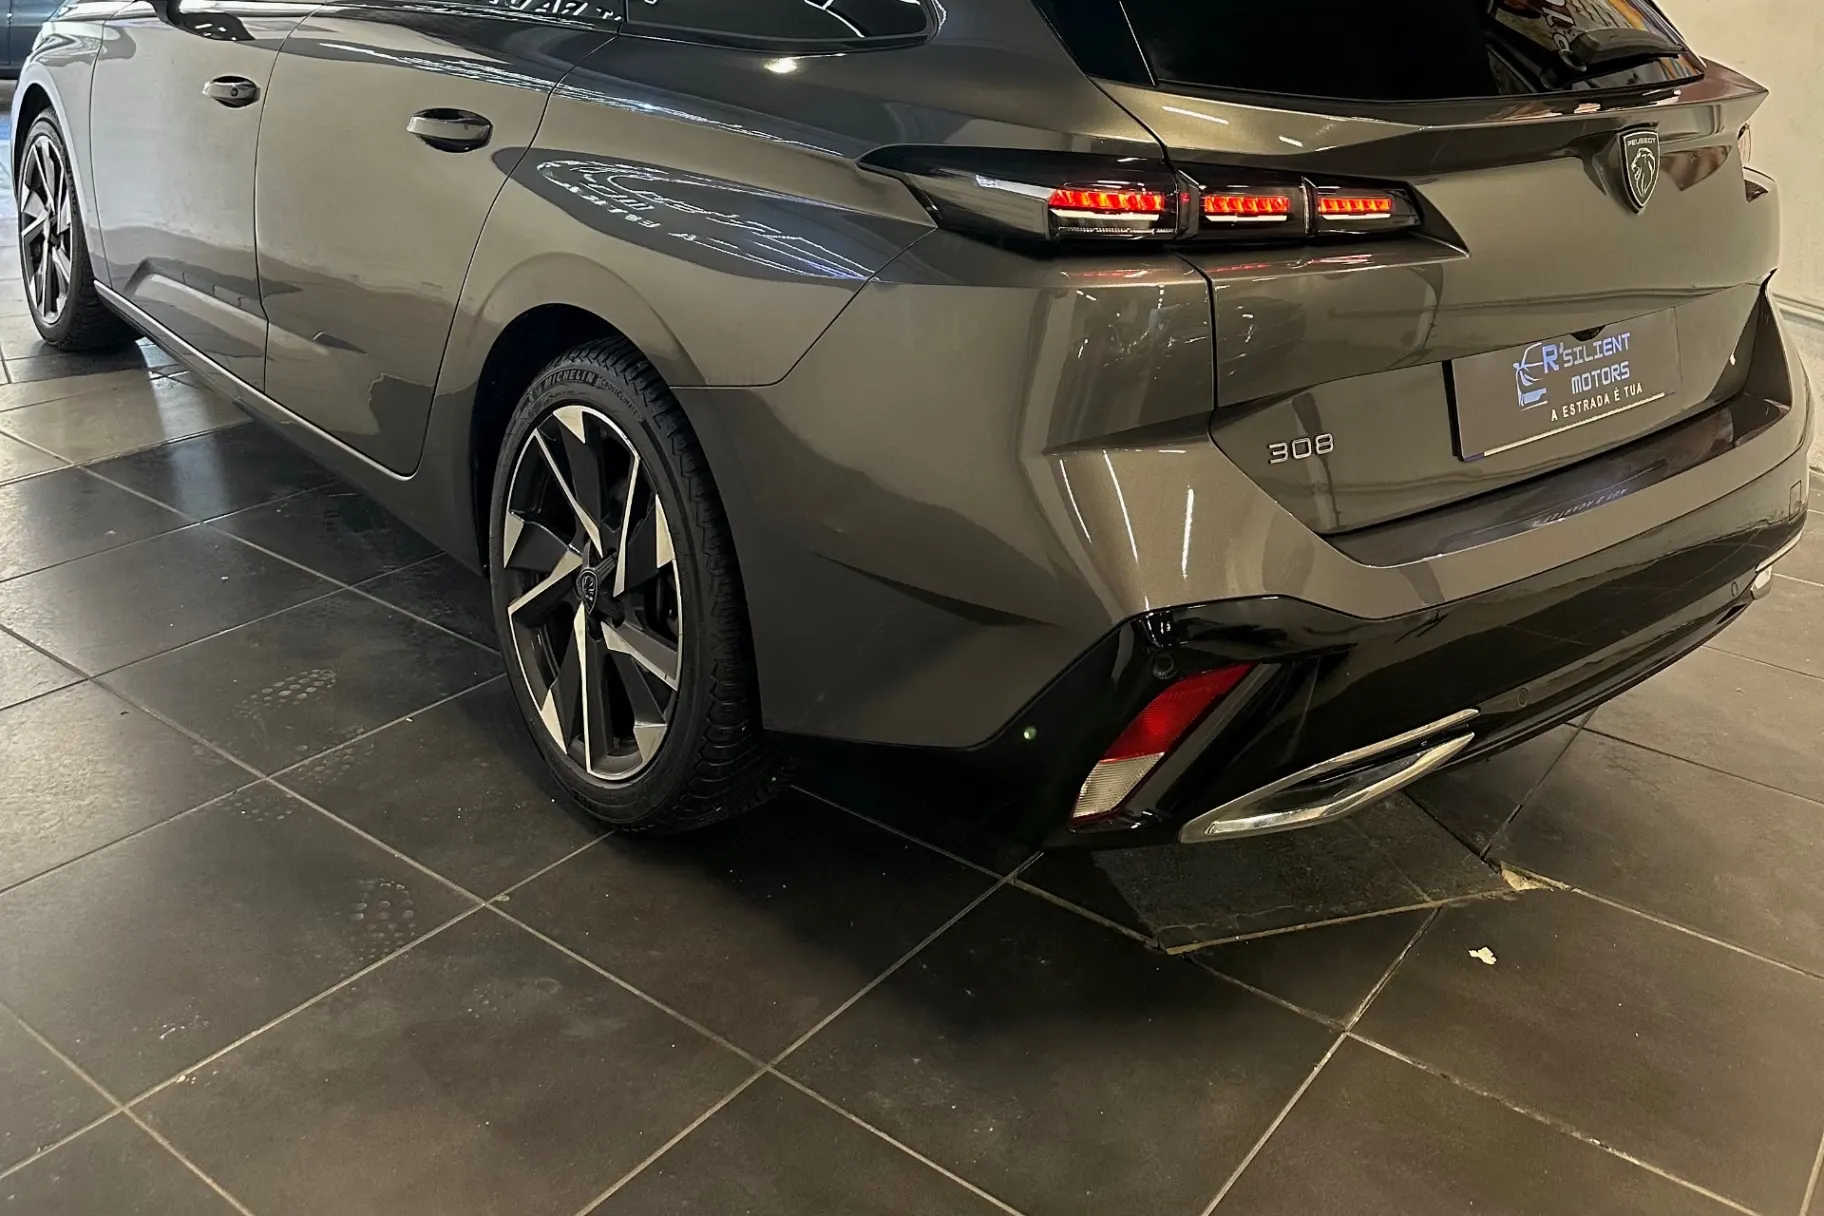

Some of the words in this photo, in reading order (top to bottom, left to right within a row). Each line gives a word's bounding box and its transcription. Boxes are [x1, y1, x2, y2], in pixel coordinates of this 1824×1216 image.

[1542, 332, 1630, 373] R'SILIENT
[544, 369, 595, 388] MICHELIN
[1571, 361, 1629, 394] MOTORS
[1551, 409, 1558, 421] A
[1562, 393, 1610, 418] ESTRADA
[1614, 387, 1620, 401] É
[1624, 382, 1643, 397] TUA
[1268, 433, 1334, 464] 308
